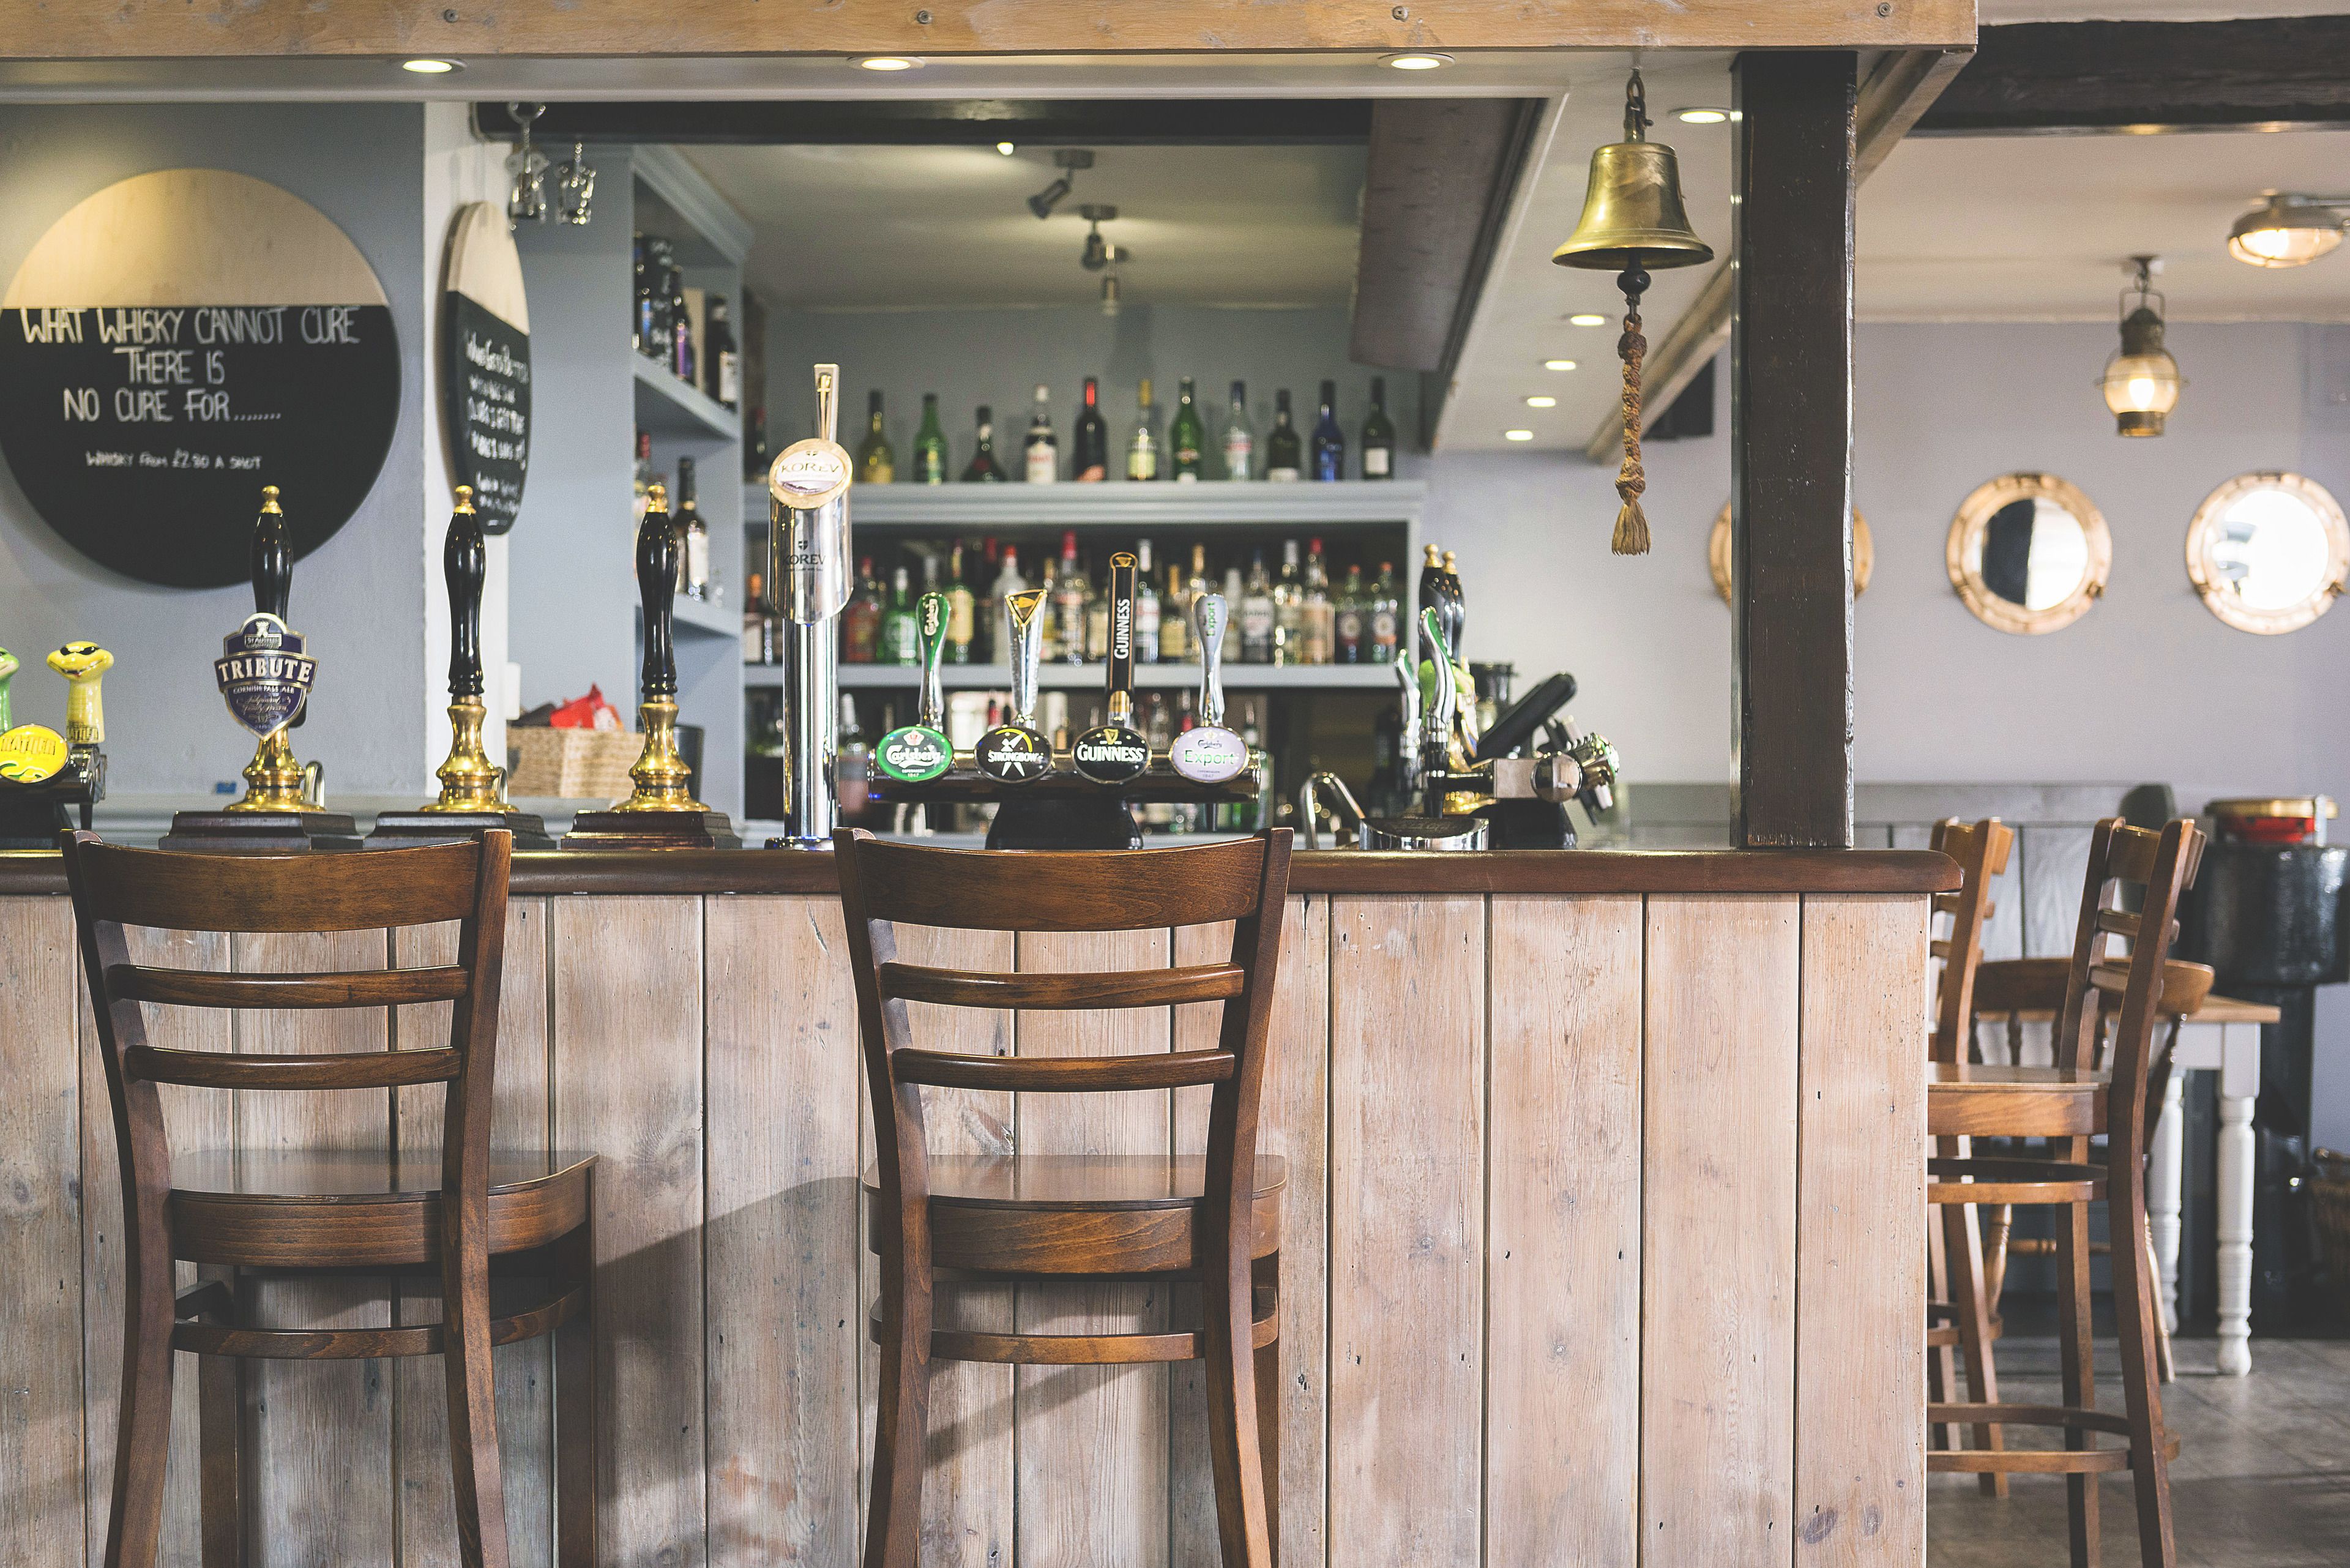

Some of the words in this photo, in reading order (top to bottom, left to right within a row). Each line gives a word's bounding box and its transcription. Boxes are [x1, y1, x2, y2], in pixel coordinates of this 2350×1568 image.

[20, 307, 88, 343] WHAT
[96, 307, 184, 344] WHISKY
[194, 306, 288, 344] CANNOT
[300, 305, 360, 344] CURE
[113, 346, 194, 384] THERE
[206, 349, 225, 384] IS
[63, 387, 100, 422] NO
[114, 387, 174, 422] CURE
[214, 455, 225, 469] A
[228, 455, 263, 469] SHOT
[781, 463, 840, 473] KOREV
[1114, 598, 1131, 660] GUINNESS
[1207, 602, 1217, 637] Export
[218, 657, 313, 682] TRIBUTE
[282, 685, 295, 694] ALE
[886, 744, 942, 769] Carlsberg
[988, 751, 1041, 763] STRONGBOW
[1076, 744, 1146, 762] GUINNESS
[1185, 750, 1235, 766] Export
